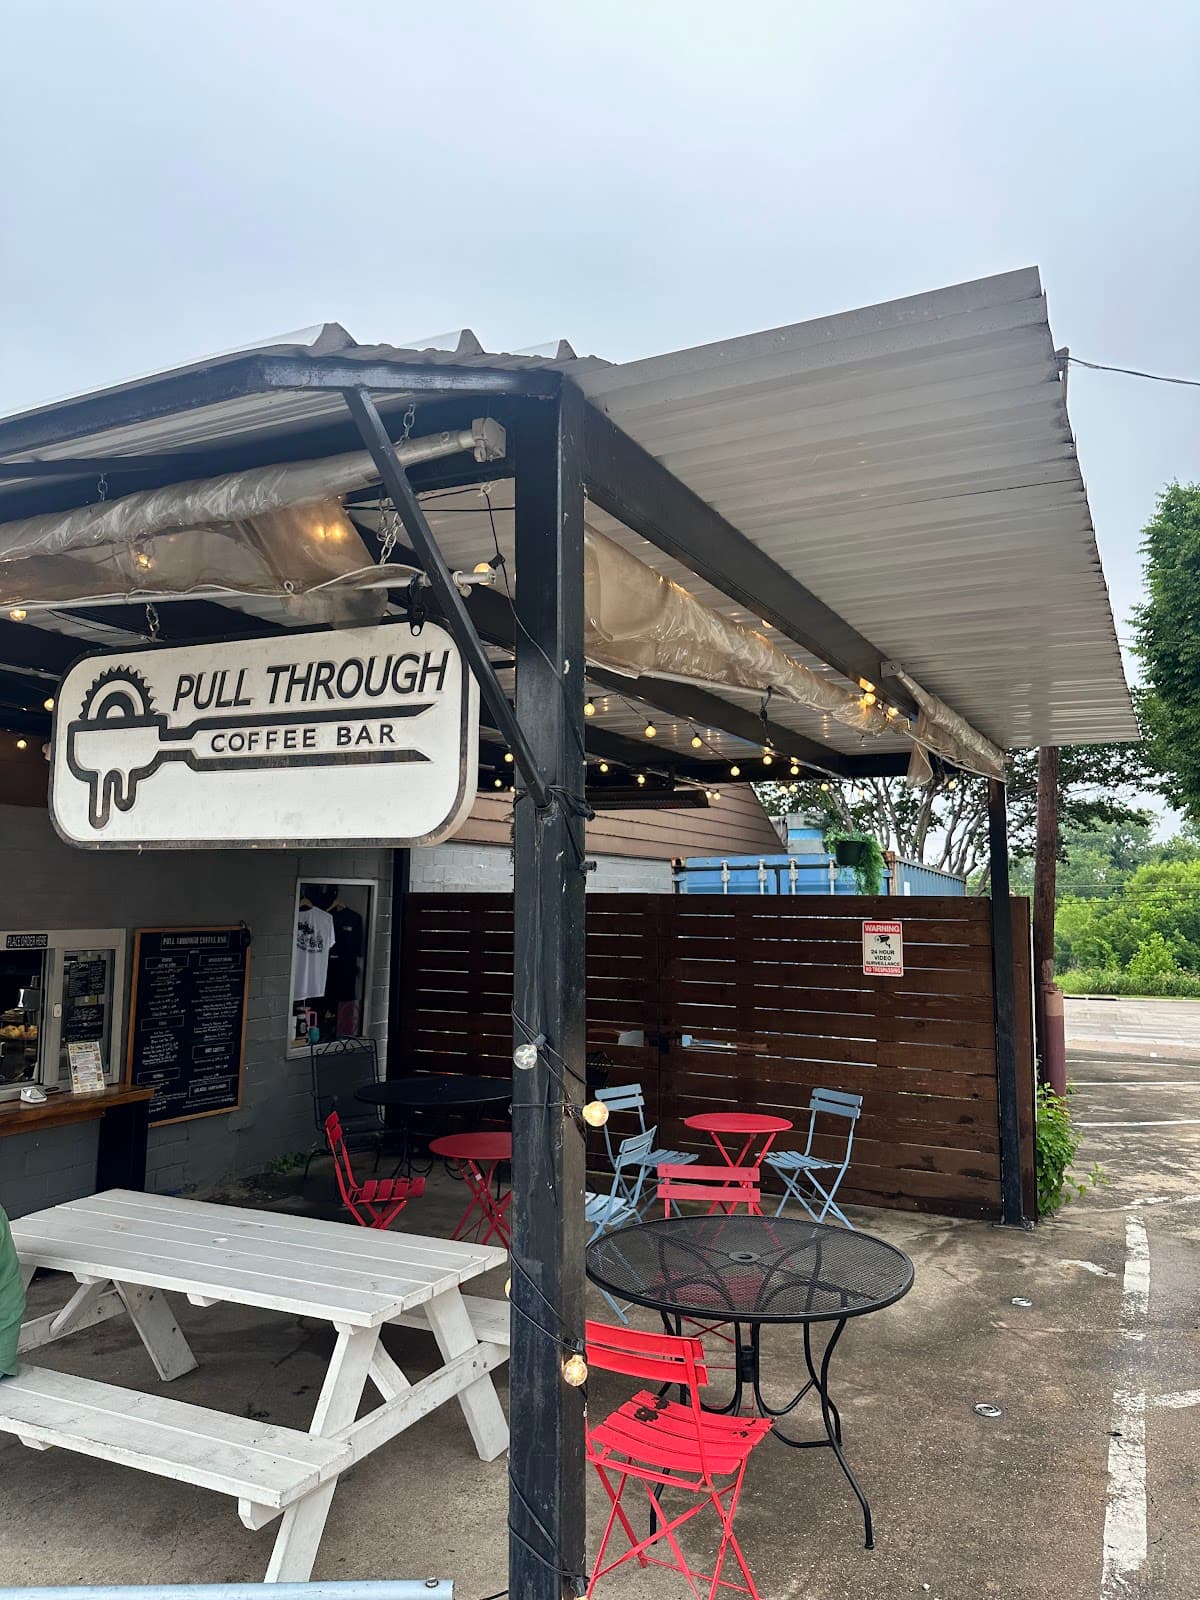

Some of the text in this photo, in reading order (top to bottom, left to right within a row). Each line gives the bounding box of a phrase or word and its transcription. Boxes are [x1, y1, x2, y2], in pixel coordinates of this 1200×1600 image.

[173, 649, 450, 712] PULL THROUGH
[210, 723, 396, 753] COFFEE BAR
[864, 924, 900, 933] WARNING
[8, 936, 47, 946] PLACE ORDER HERE
